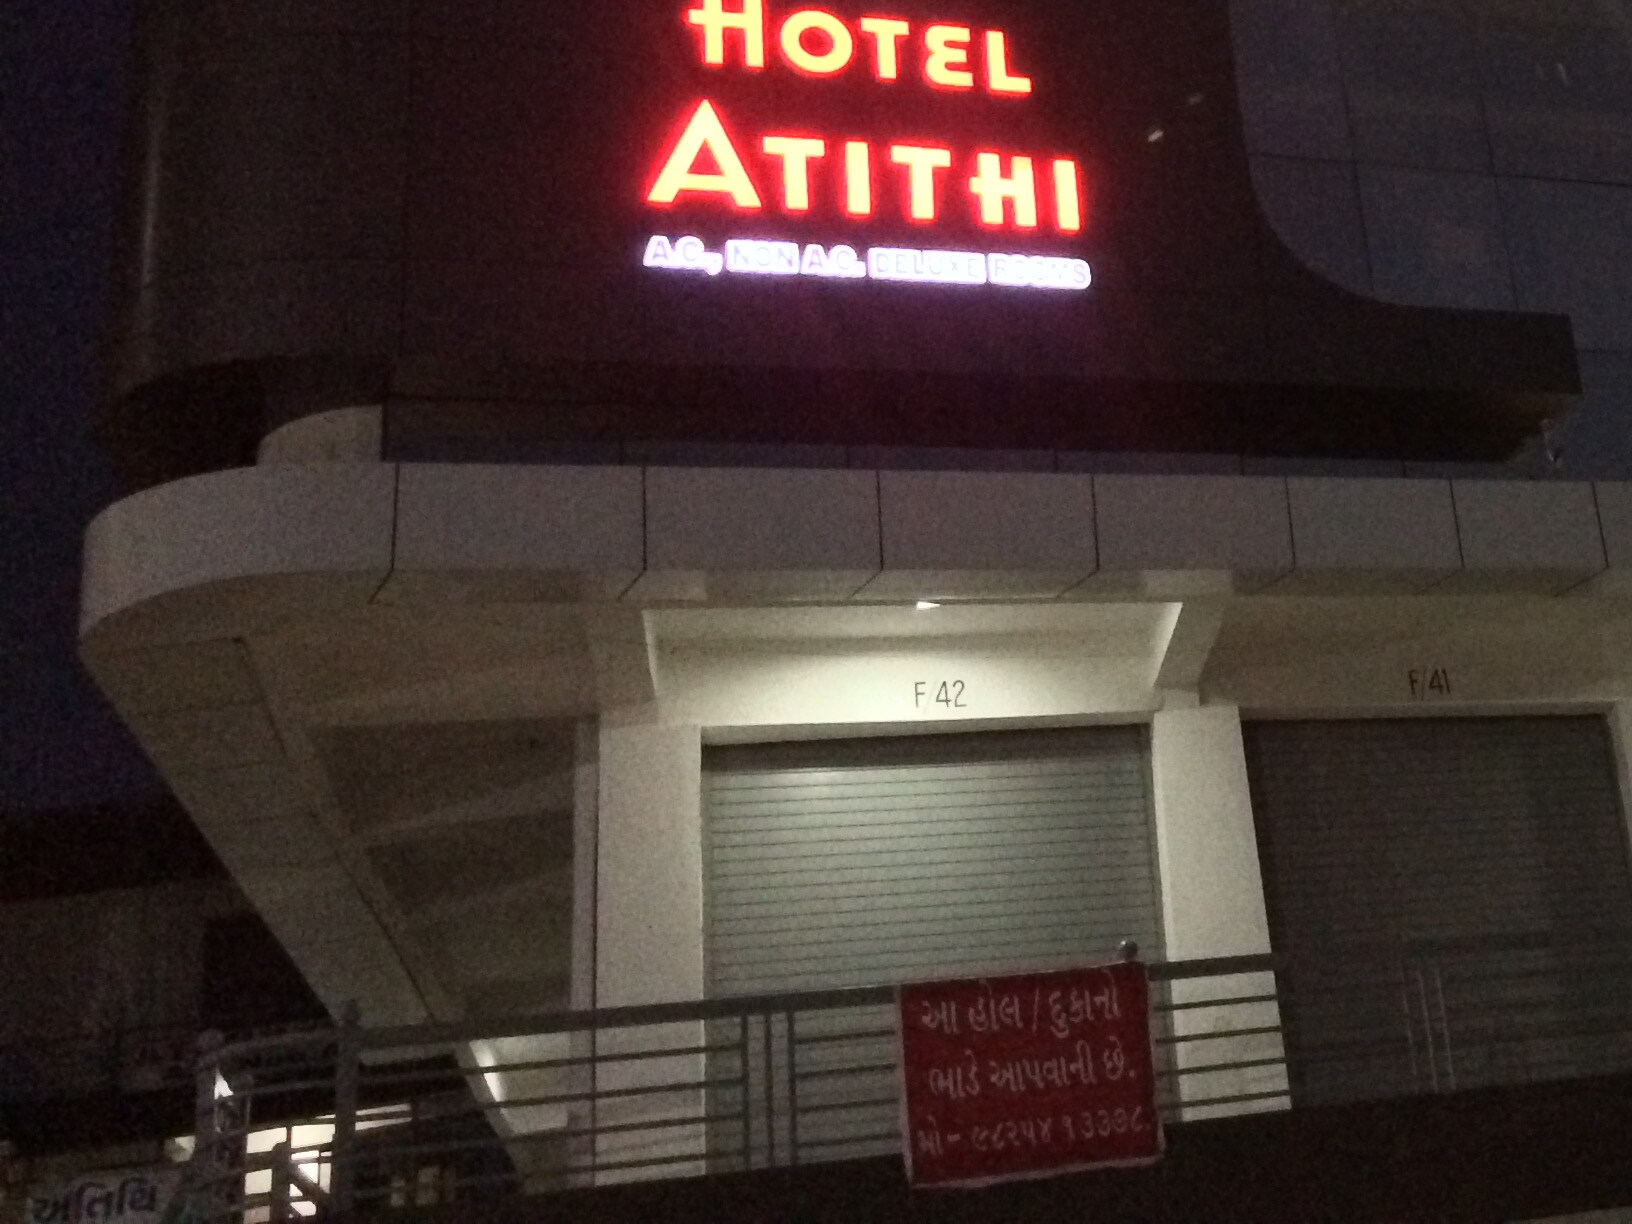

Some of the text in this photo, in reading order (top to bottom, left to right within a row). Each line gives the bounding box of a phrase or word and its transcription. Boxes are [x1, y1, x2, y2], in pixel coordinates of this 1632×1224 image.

[645, 98, 1082, 232] ATITHI
[725, 238, 799, 276] NON
[867, 246, 987, 286] DELUXE
[920, 998, 961, 1034] આ
